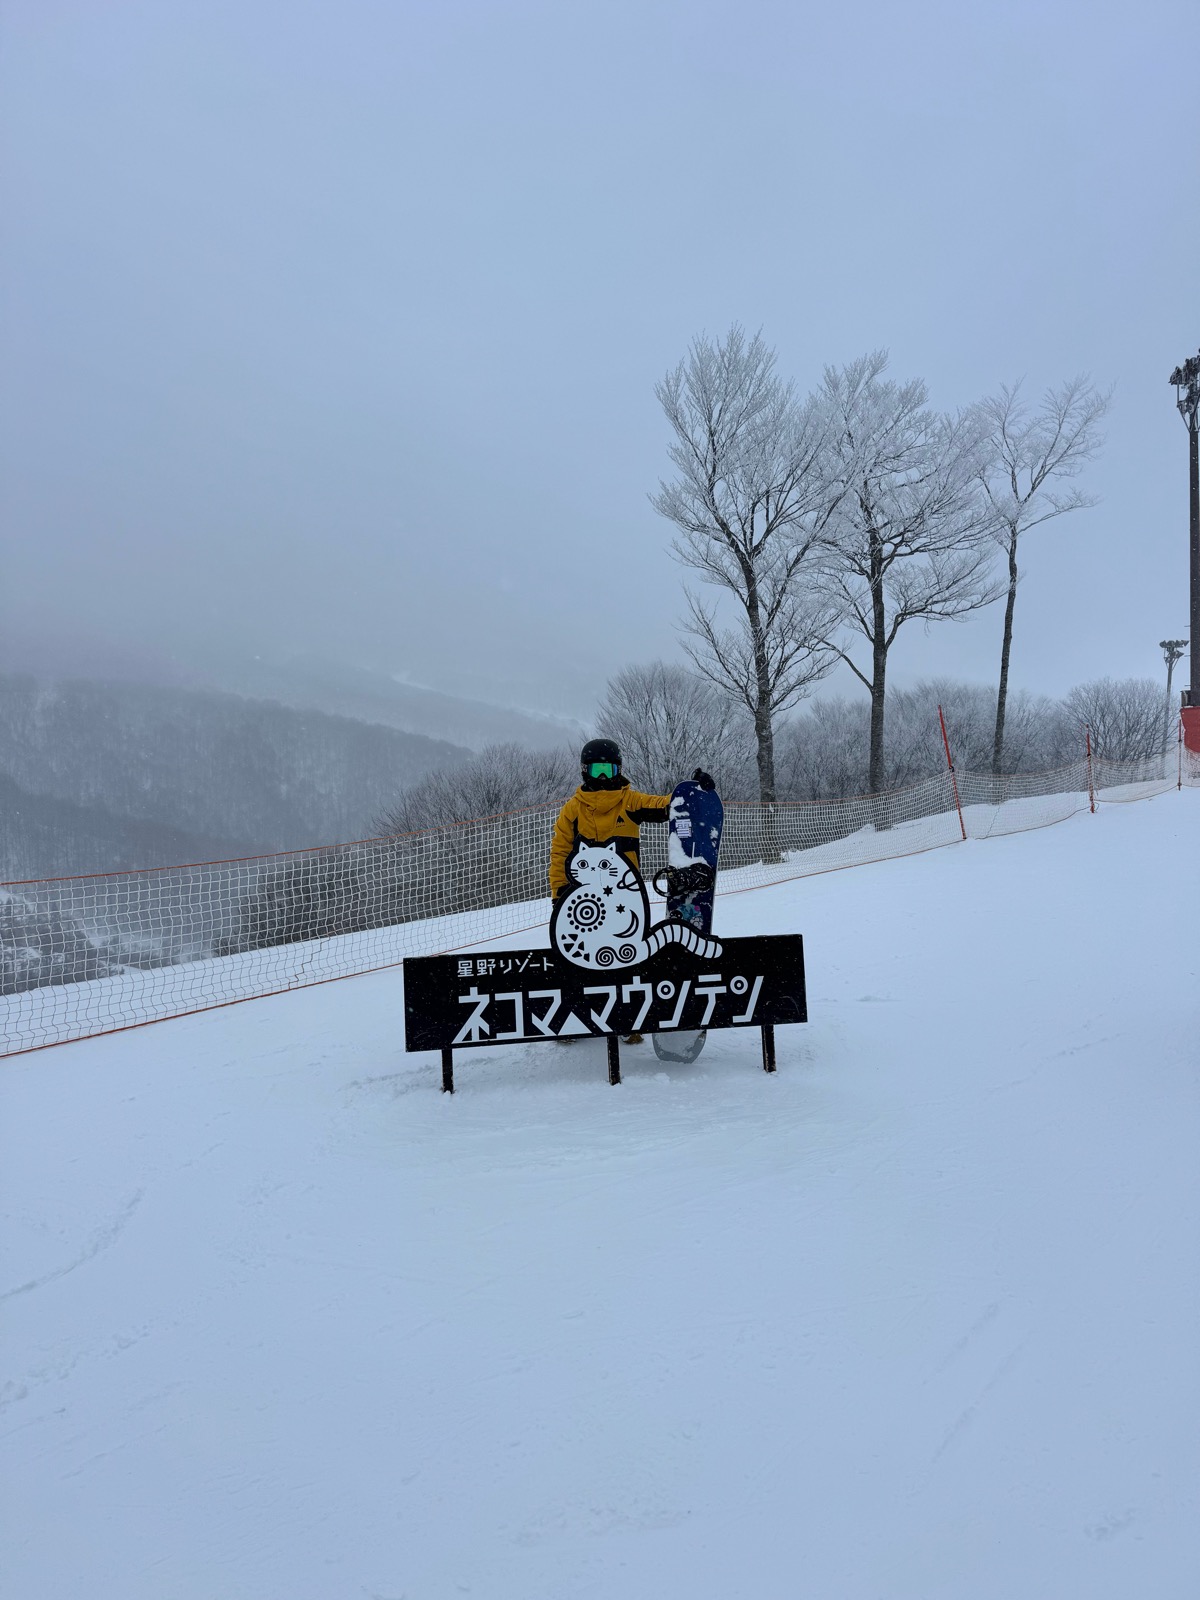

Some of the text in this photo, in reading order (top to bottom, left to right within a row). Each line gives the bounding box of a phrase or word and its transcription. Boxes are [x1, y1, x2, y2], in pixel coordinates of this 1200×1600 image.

[457, 952, 554, 977] 星野リゾート
